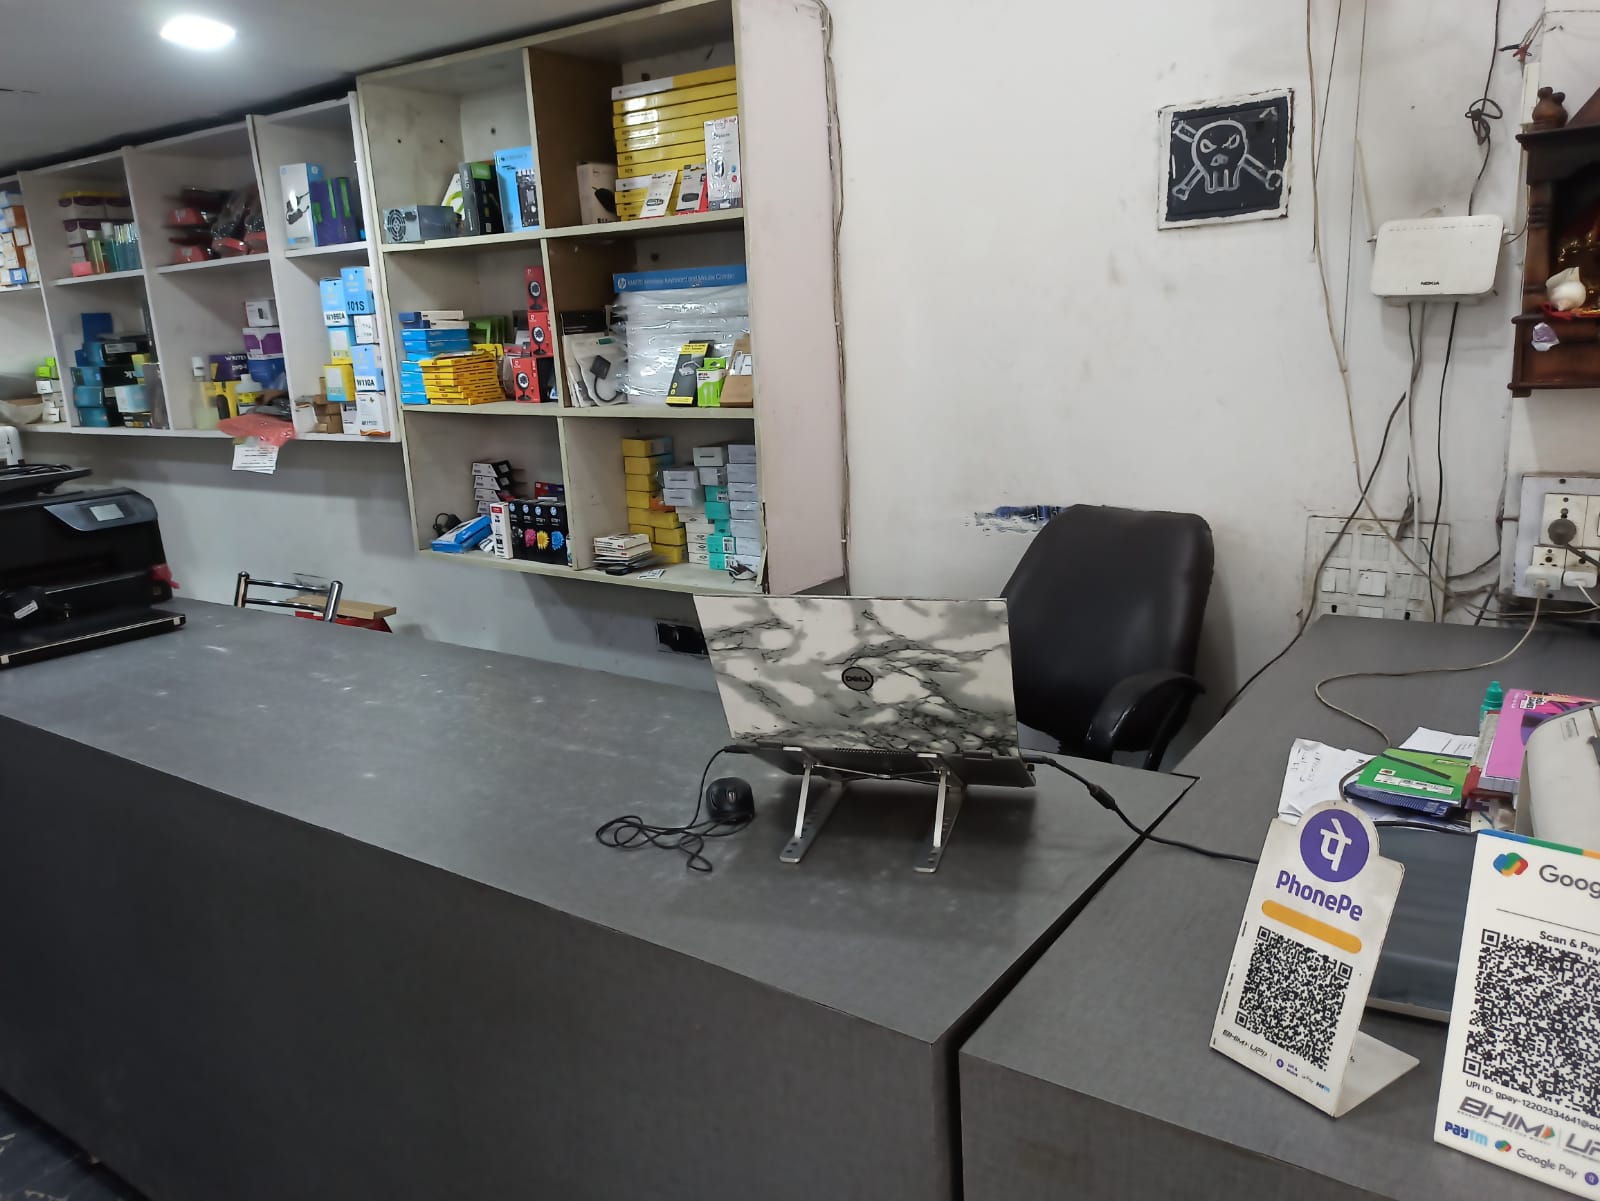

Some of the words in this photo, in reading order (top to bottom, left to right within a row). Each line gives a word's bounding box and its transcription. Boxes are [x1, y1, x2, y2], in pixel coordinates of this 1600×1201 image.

[347, 301, 365, 311] 101S
[1276, 870, 1363, 921] PhonePe
[1539, 864, 1600, 899] Goog
[1540, 930, 1566, 945] Scan
[1569, 939, 1577, 948] &
[1581, 941, 1600, 956] Pay
[1466, 1079, 1481, 1090] UPI
[1482, 1084, 1493, 1095] ID:
[1459, 1096, 1545, 1137] BHIM
[1516, 1148, 1556, 1169] Google
[1559, 1164, 1577, 1178] Pay
